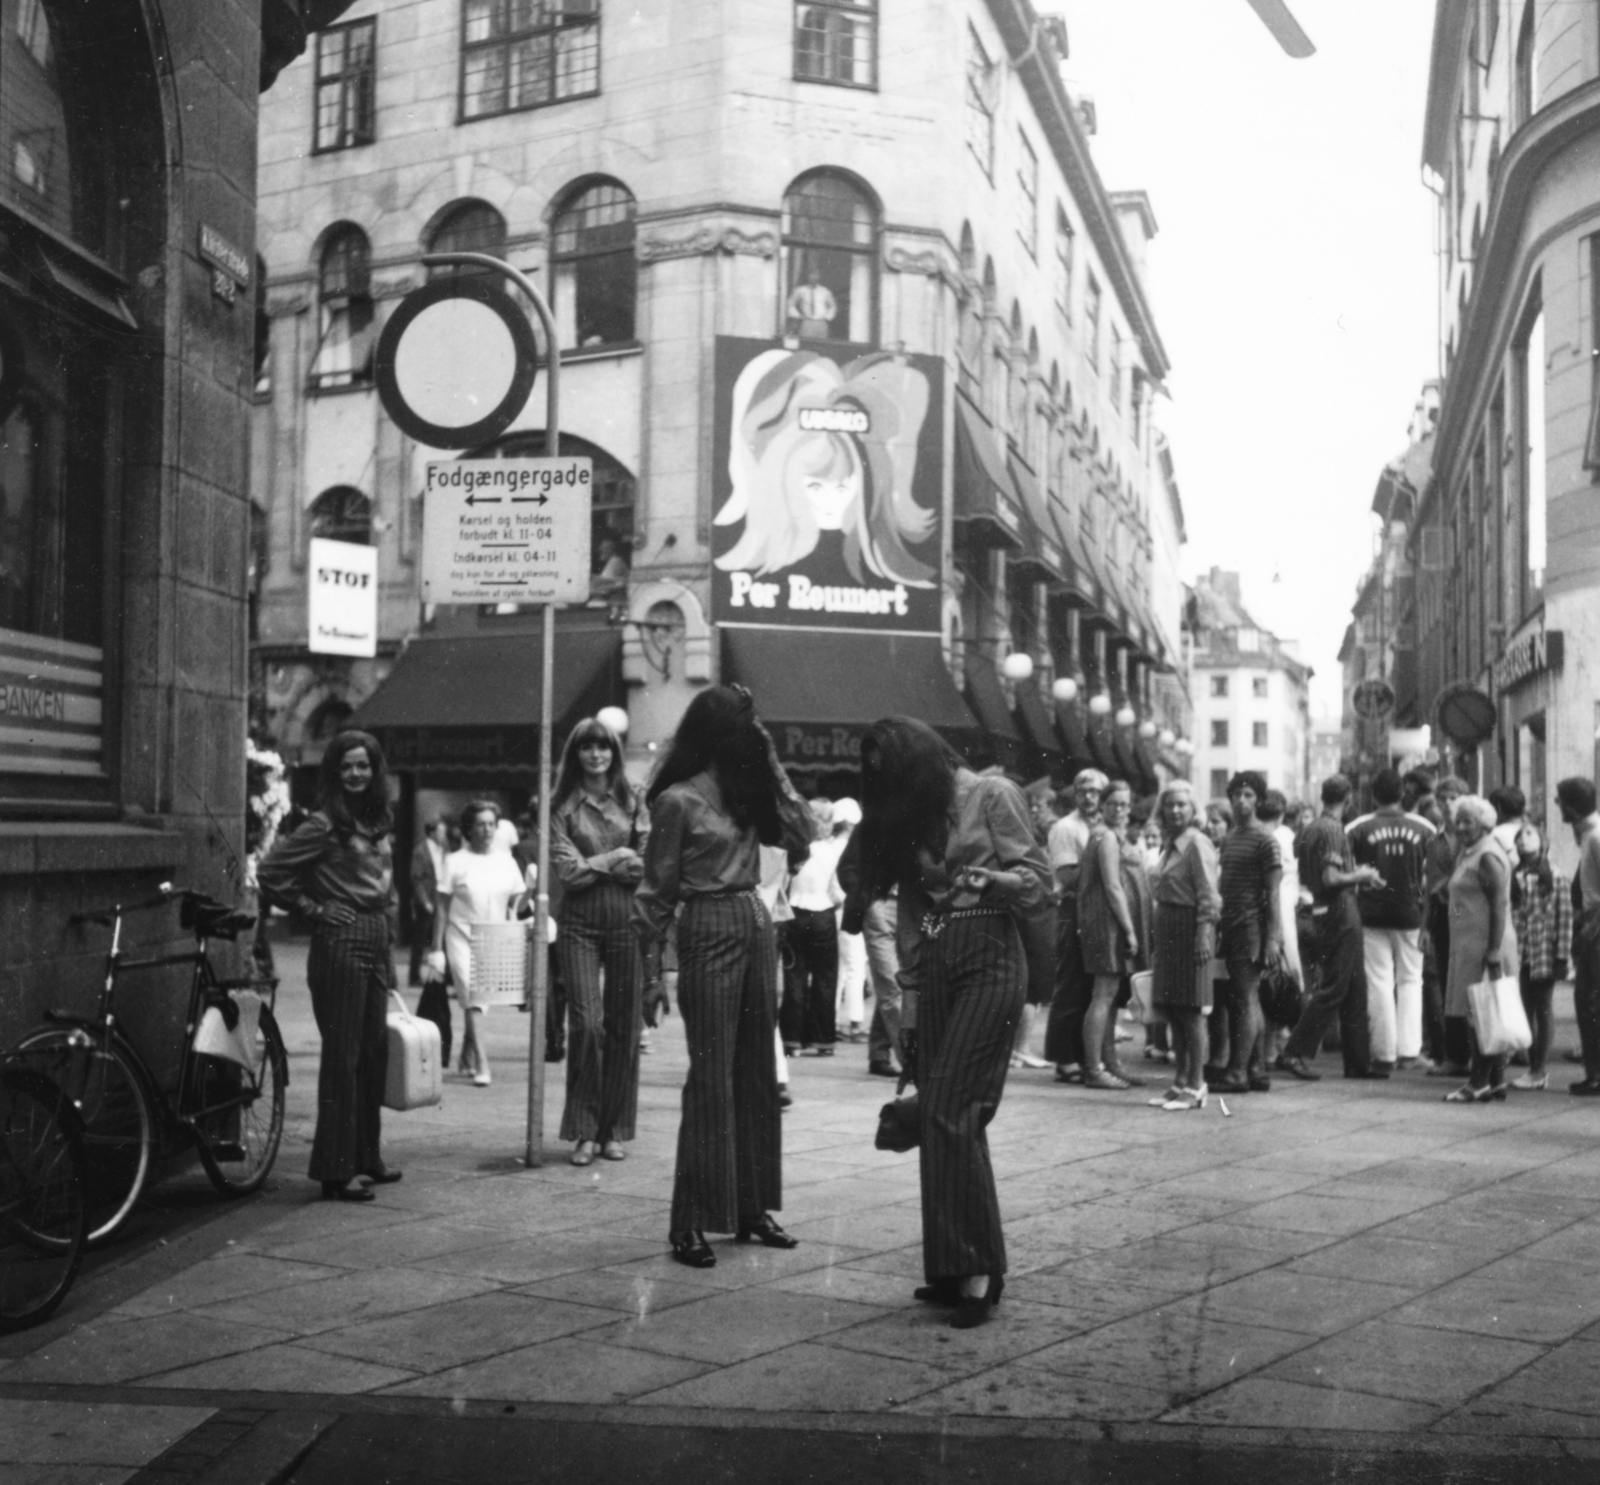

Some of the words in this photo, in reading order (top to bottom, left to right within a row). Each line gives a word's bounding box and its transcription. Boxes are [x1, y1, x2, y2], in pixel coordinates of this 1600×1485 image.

[427, 463, 591, 493] Fodgængergade
[459, 513, 493, 526] Kørsel
[498, 516, 511, 529] og
[516, 513, 553, 525] holden
[459, 528, 498, 541] forbudt
[503, 528, 515, 540] kl.
[520, 527, 553, 540] 11-04
[507, 551, 519, 563] kl.
[523, 550, 556, 563] 04-11
[484, 569, 495, 578] for
[493, 588, 501, 598] af
[528, 588, 556, 598] forbudt
[730, 571, 781, 609] Per
[787, 574, 909, 616] Reumert
[786, 726, 830, 756] Per
